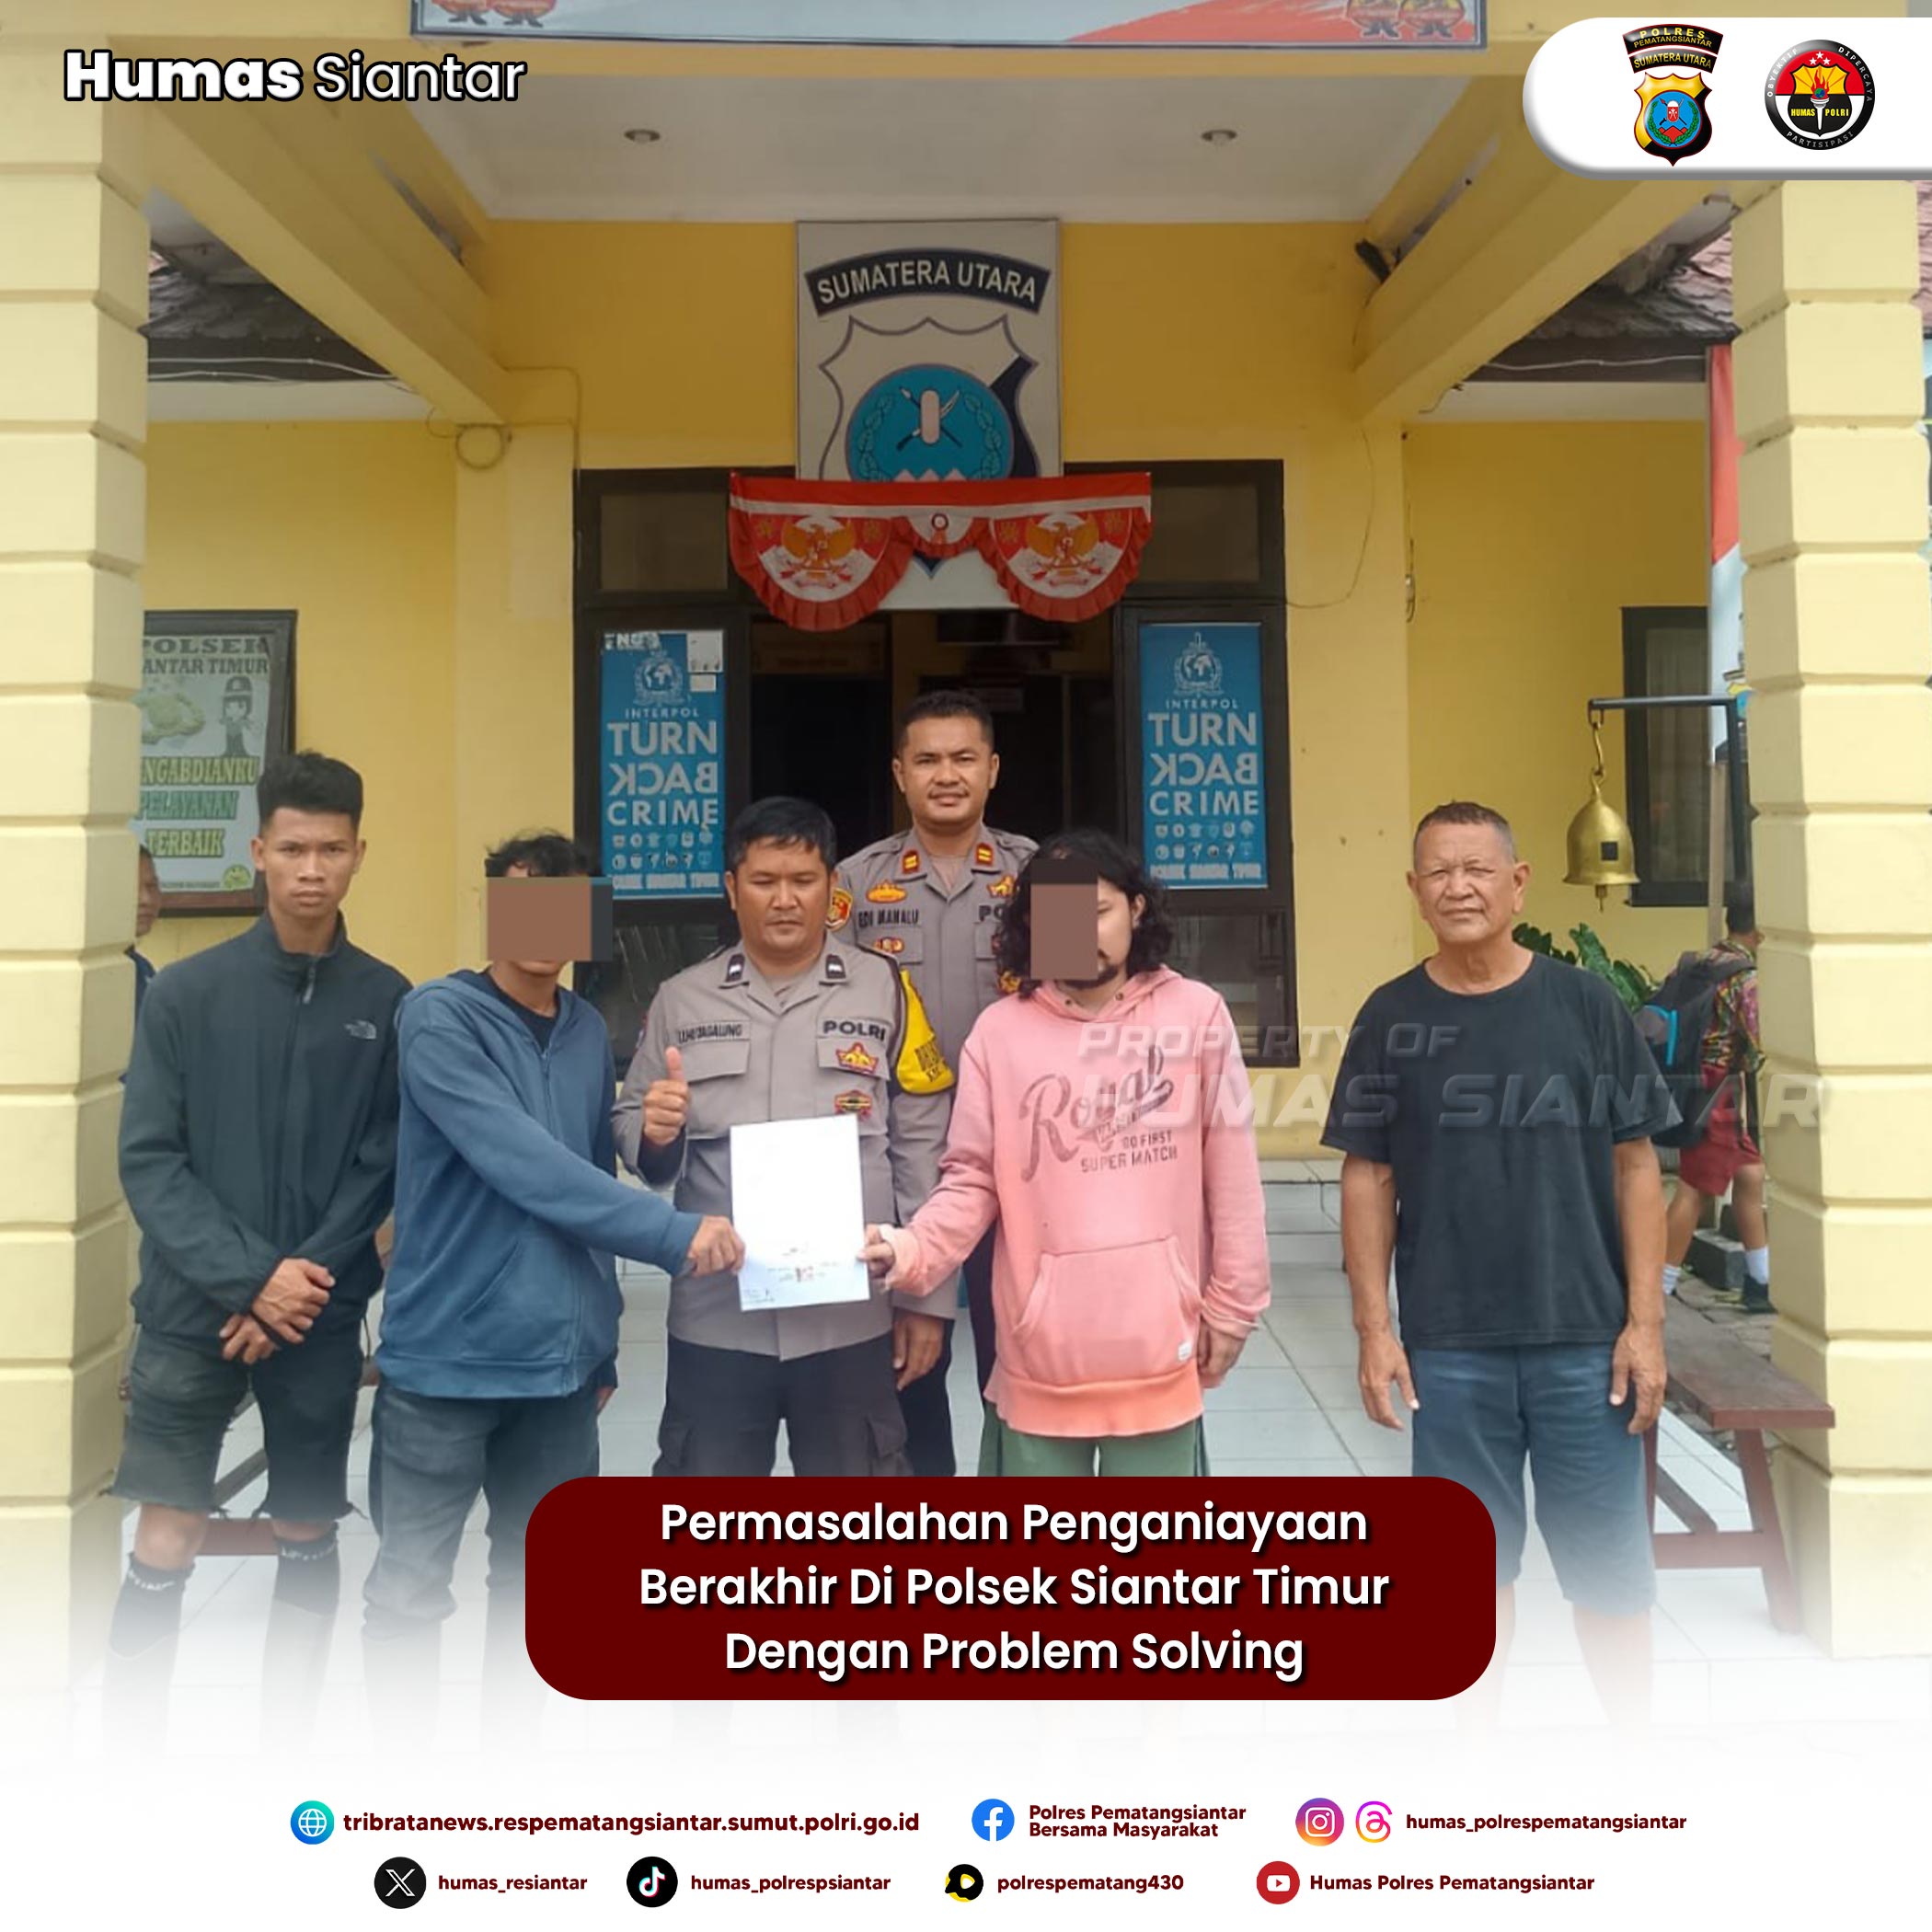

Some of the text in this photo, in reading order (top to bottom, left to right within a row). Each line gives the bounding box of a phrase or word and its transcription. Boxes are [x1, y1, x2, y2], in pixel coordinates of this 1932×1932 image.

[817, 259, 1036, 304] SUMATERA UTARA
[209, 659, 268, 674] TIMUR
[625, 707, 699, 719] INTERPOL
[1166, 697, 1238, 709] INTERPOL
[607, 720, 718, 756] TURN
[1147, 712, 1258, 747] TURN
[606, 799, 719, 826] CRIME
[1150, 790, 1259, 816] CRIME
[146, 828, 225, 858] TERBAIK
[823, 1020, 886, 1041] POLRI
[1018, 1045, 1175, 1183] Royal
[1140, 1129, 1172, 1147] FIRST
[1080, 1145, 1178, 1173] SUPER MATCH
